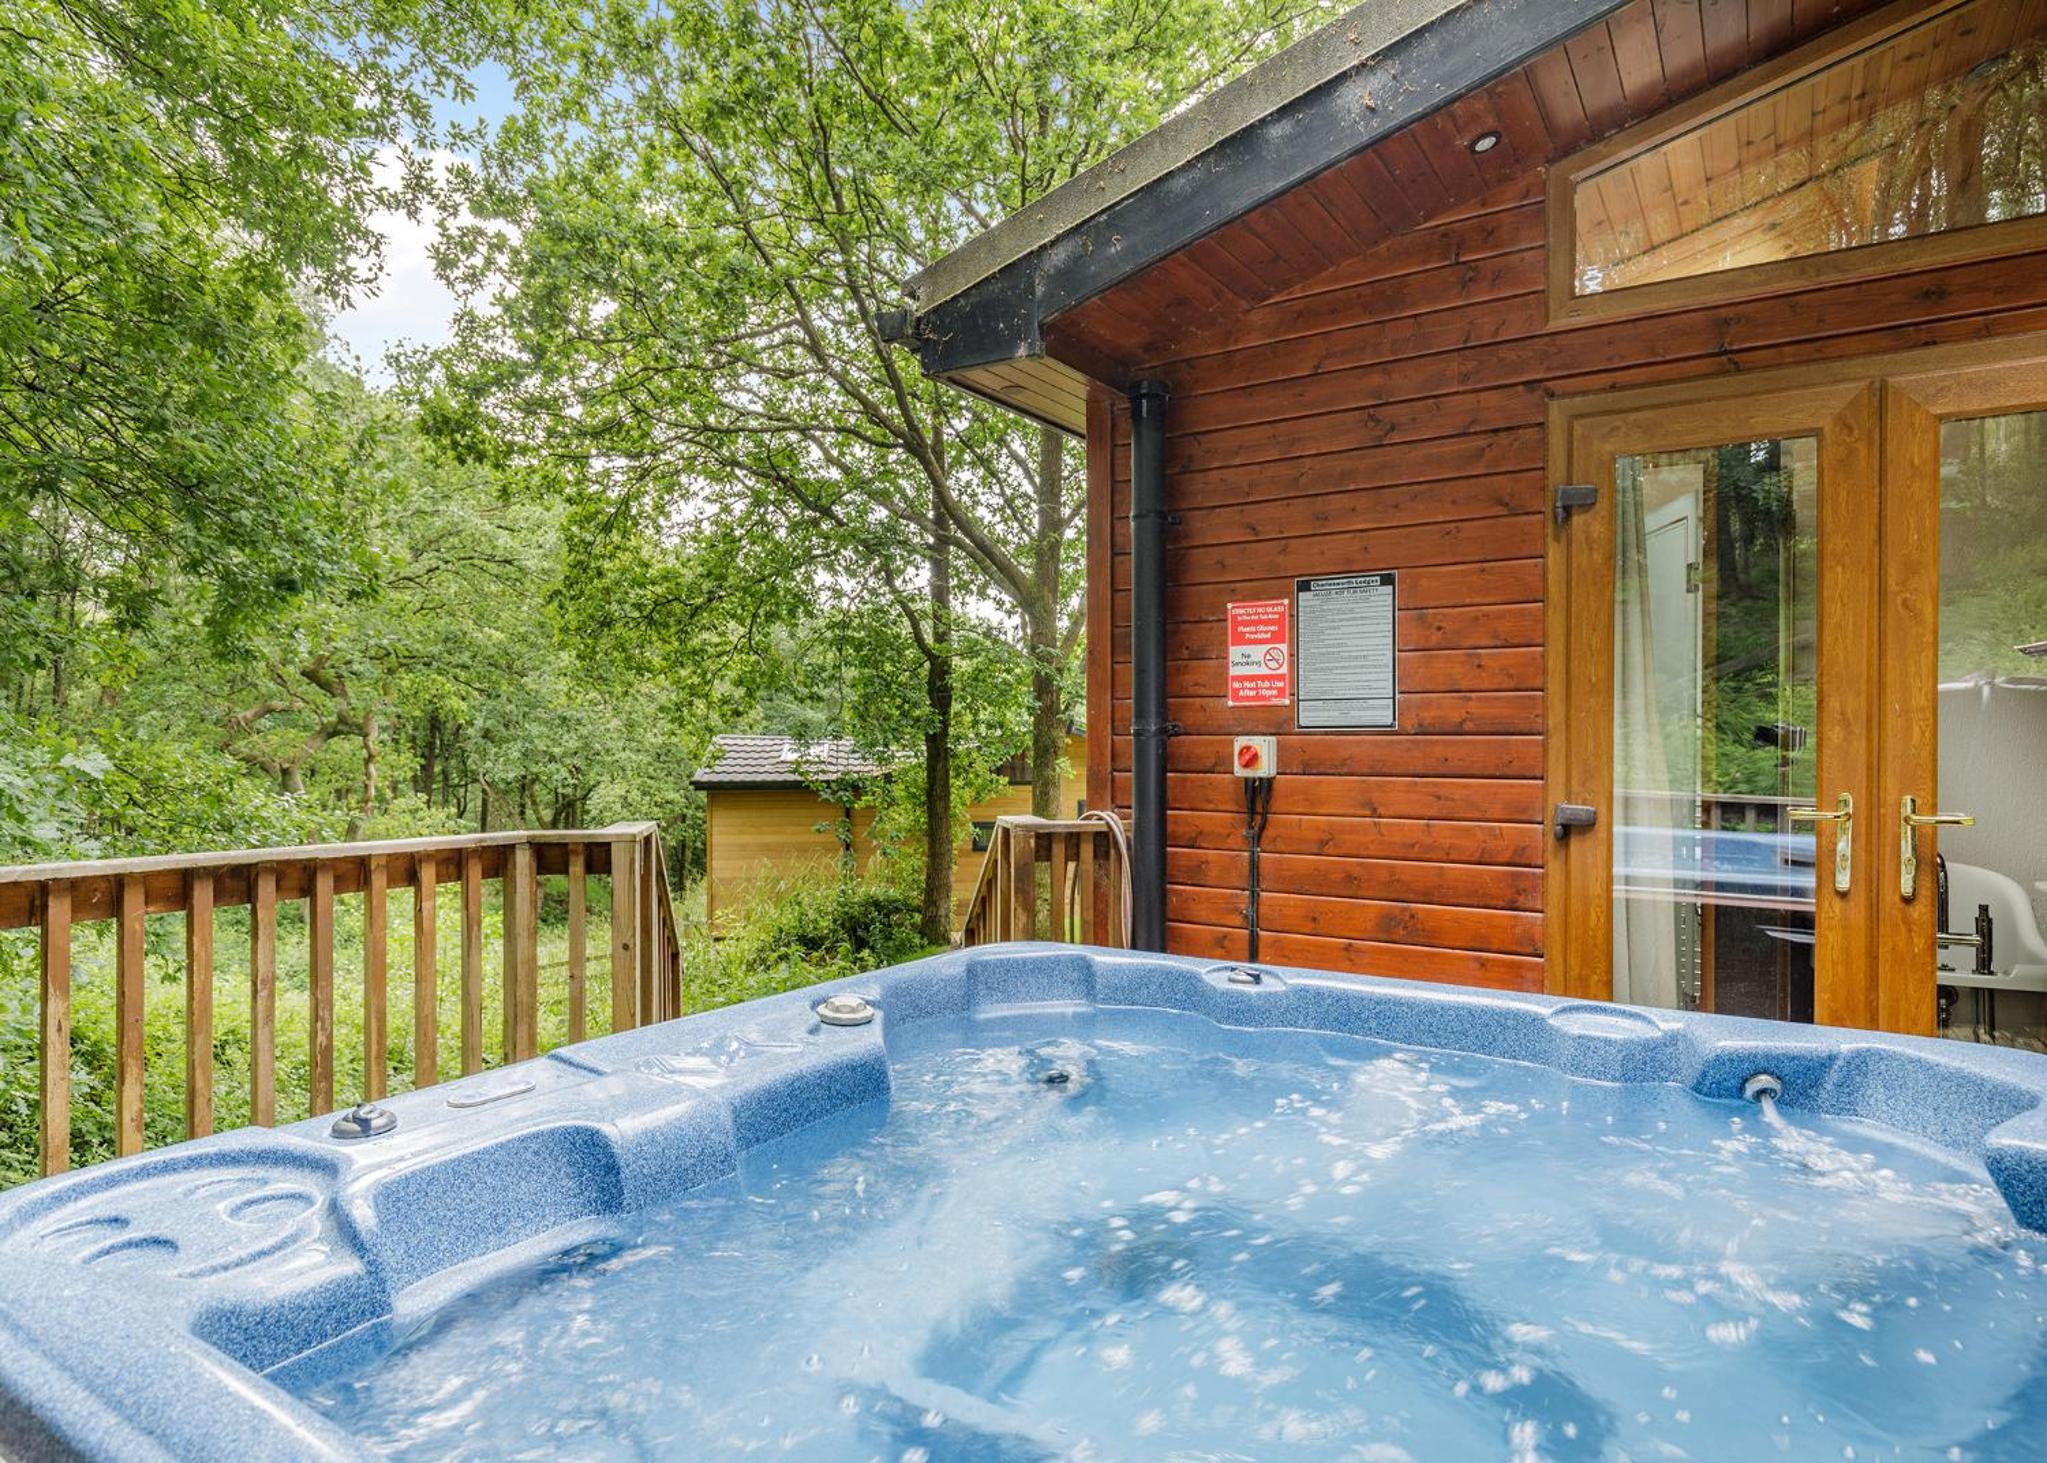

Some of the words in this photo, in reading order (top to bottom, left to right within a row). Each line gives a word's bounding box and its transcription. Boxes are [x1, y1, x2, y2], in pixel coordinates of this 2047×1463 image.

[1355, 578, 1379, 586] Lodges
[1241, 652, 1251, 660] No
[1231, 660, 1262, 668] Smoking
[1232, 681, 1243, 689] No
[1244, 680, 1256, 688] Hot
[1239, 689, 1257, 697] After
[1258, 688, 1278, 698] 10pm
